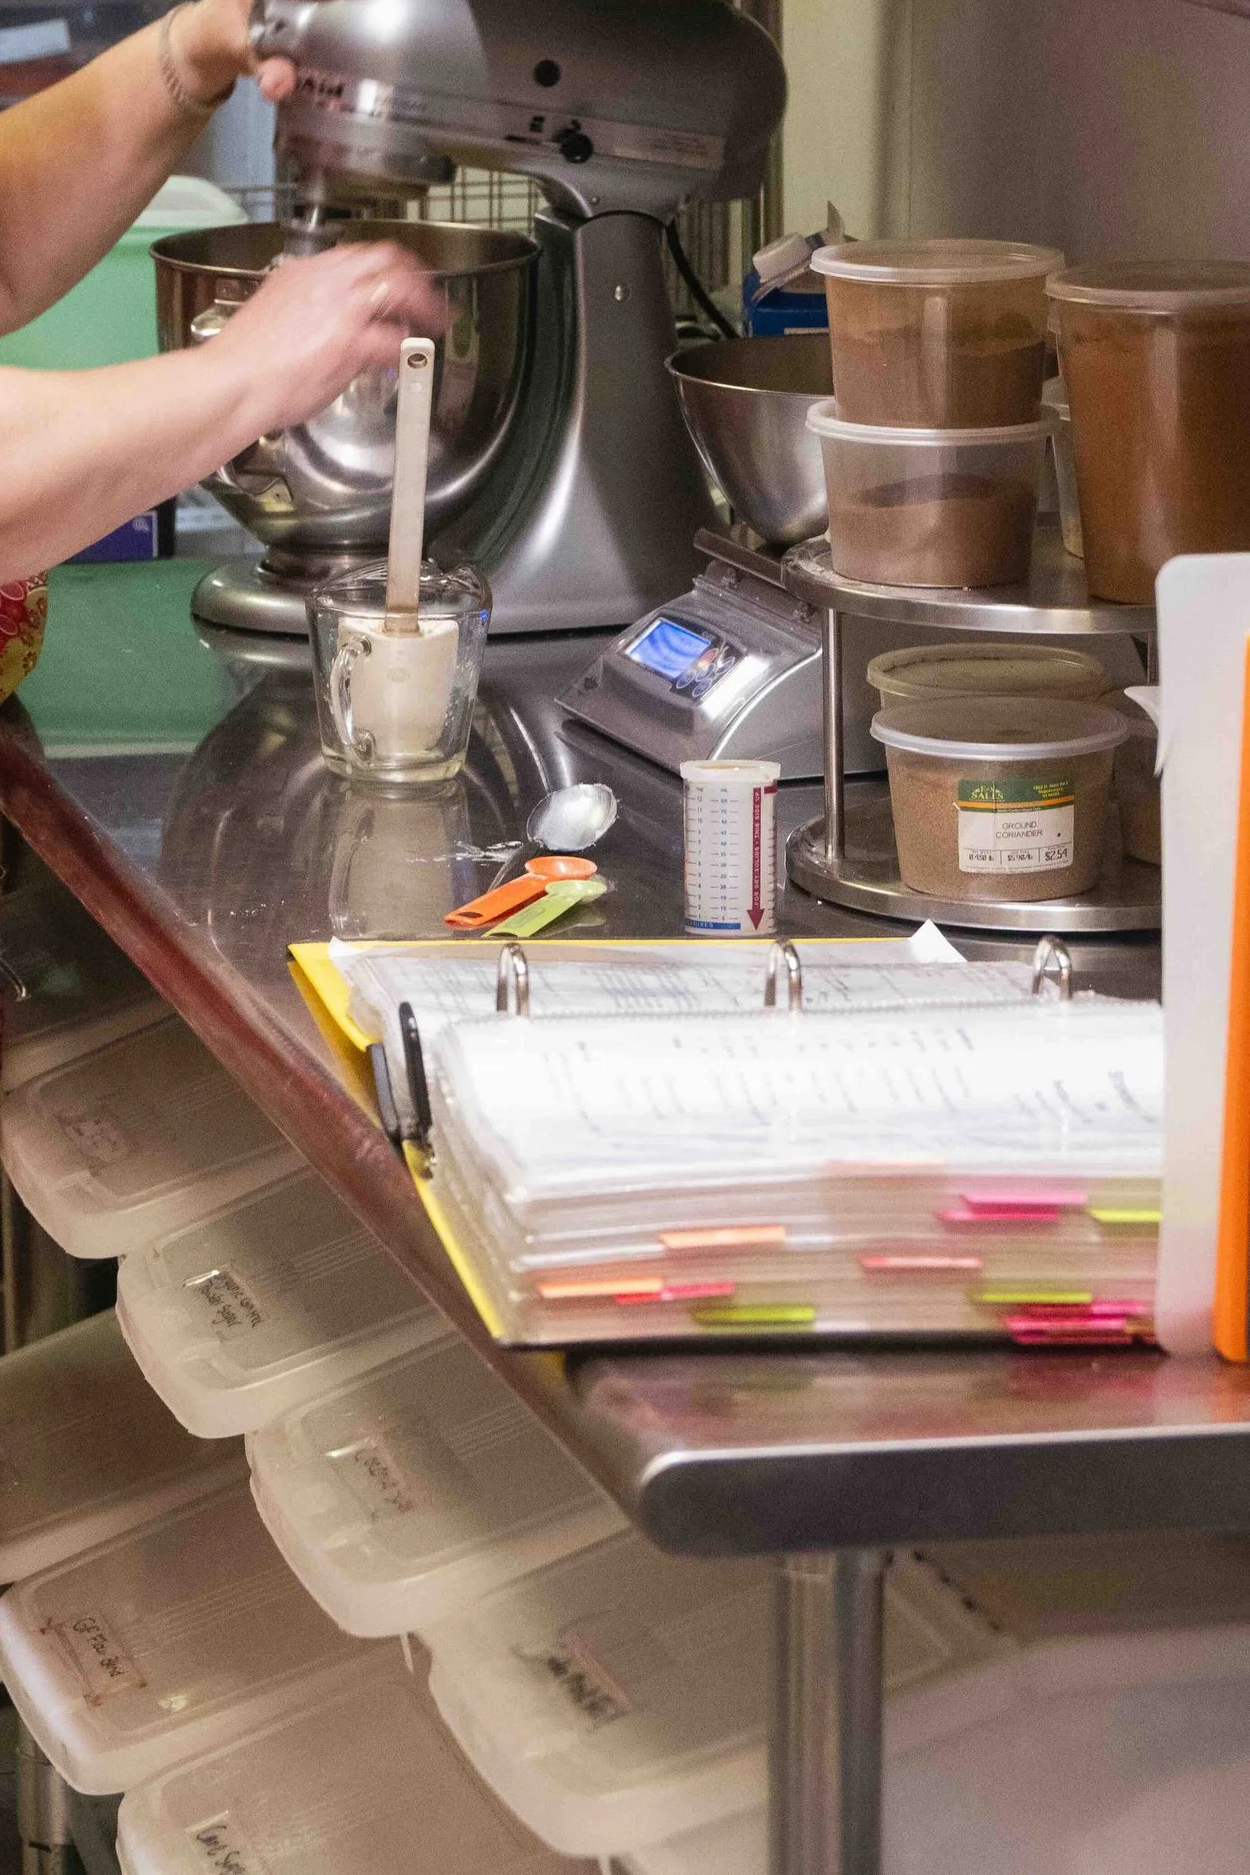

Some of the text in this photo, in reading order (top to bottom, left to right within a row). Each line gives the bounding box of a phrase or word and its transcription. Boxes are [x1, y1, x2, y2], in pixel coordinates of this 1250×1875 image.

[1001, 820, 1037, 830] GROUND
[995, 829, 1043, 839] CORIANDER
[1044, 847, 1068, 862] $2.54
